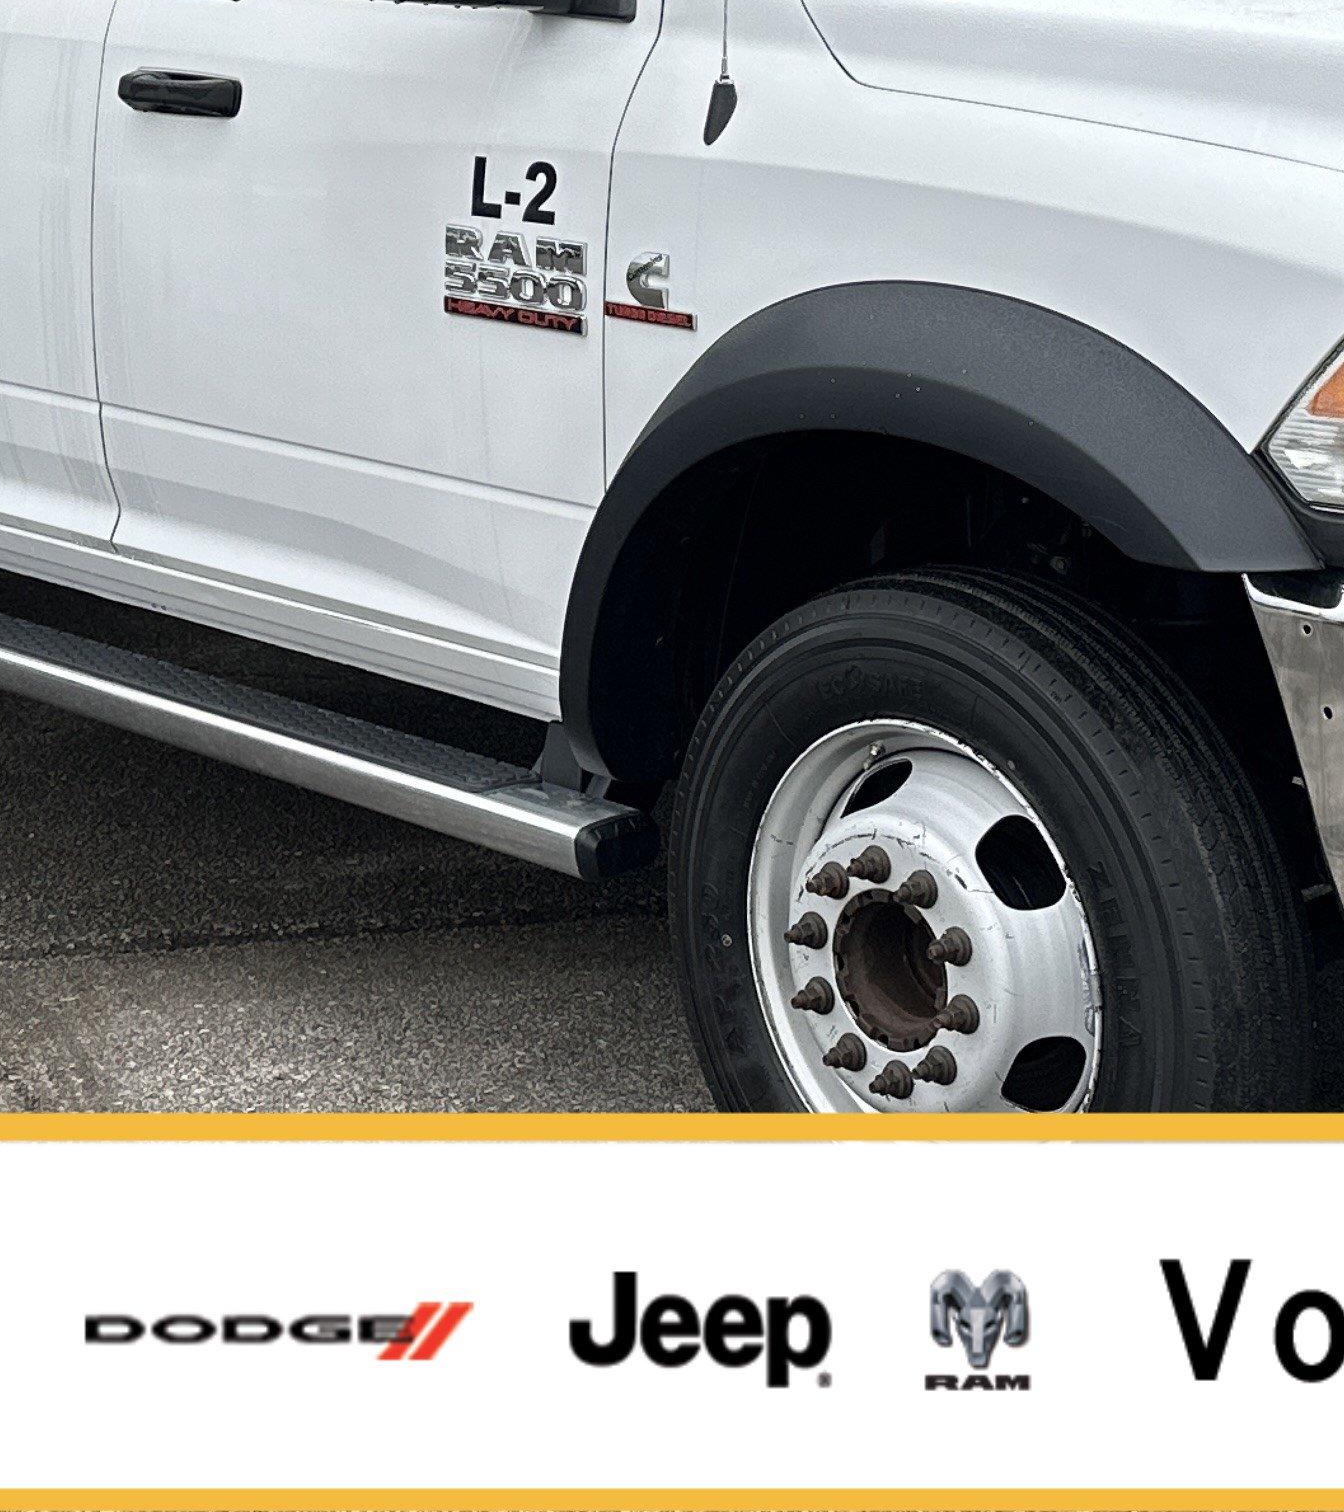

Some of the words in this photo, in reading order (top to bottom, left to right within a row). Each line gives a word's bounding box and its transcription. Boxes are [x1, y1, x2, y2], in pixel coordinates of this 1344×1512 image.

[471, 156, 557, 225] L-2
[446, 223, 588, 276] RAM
[444, 259, 587, 312] 5500
[447, 298, 514, 321] HEAVY
[518, 309, 576, 331] DUTY
